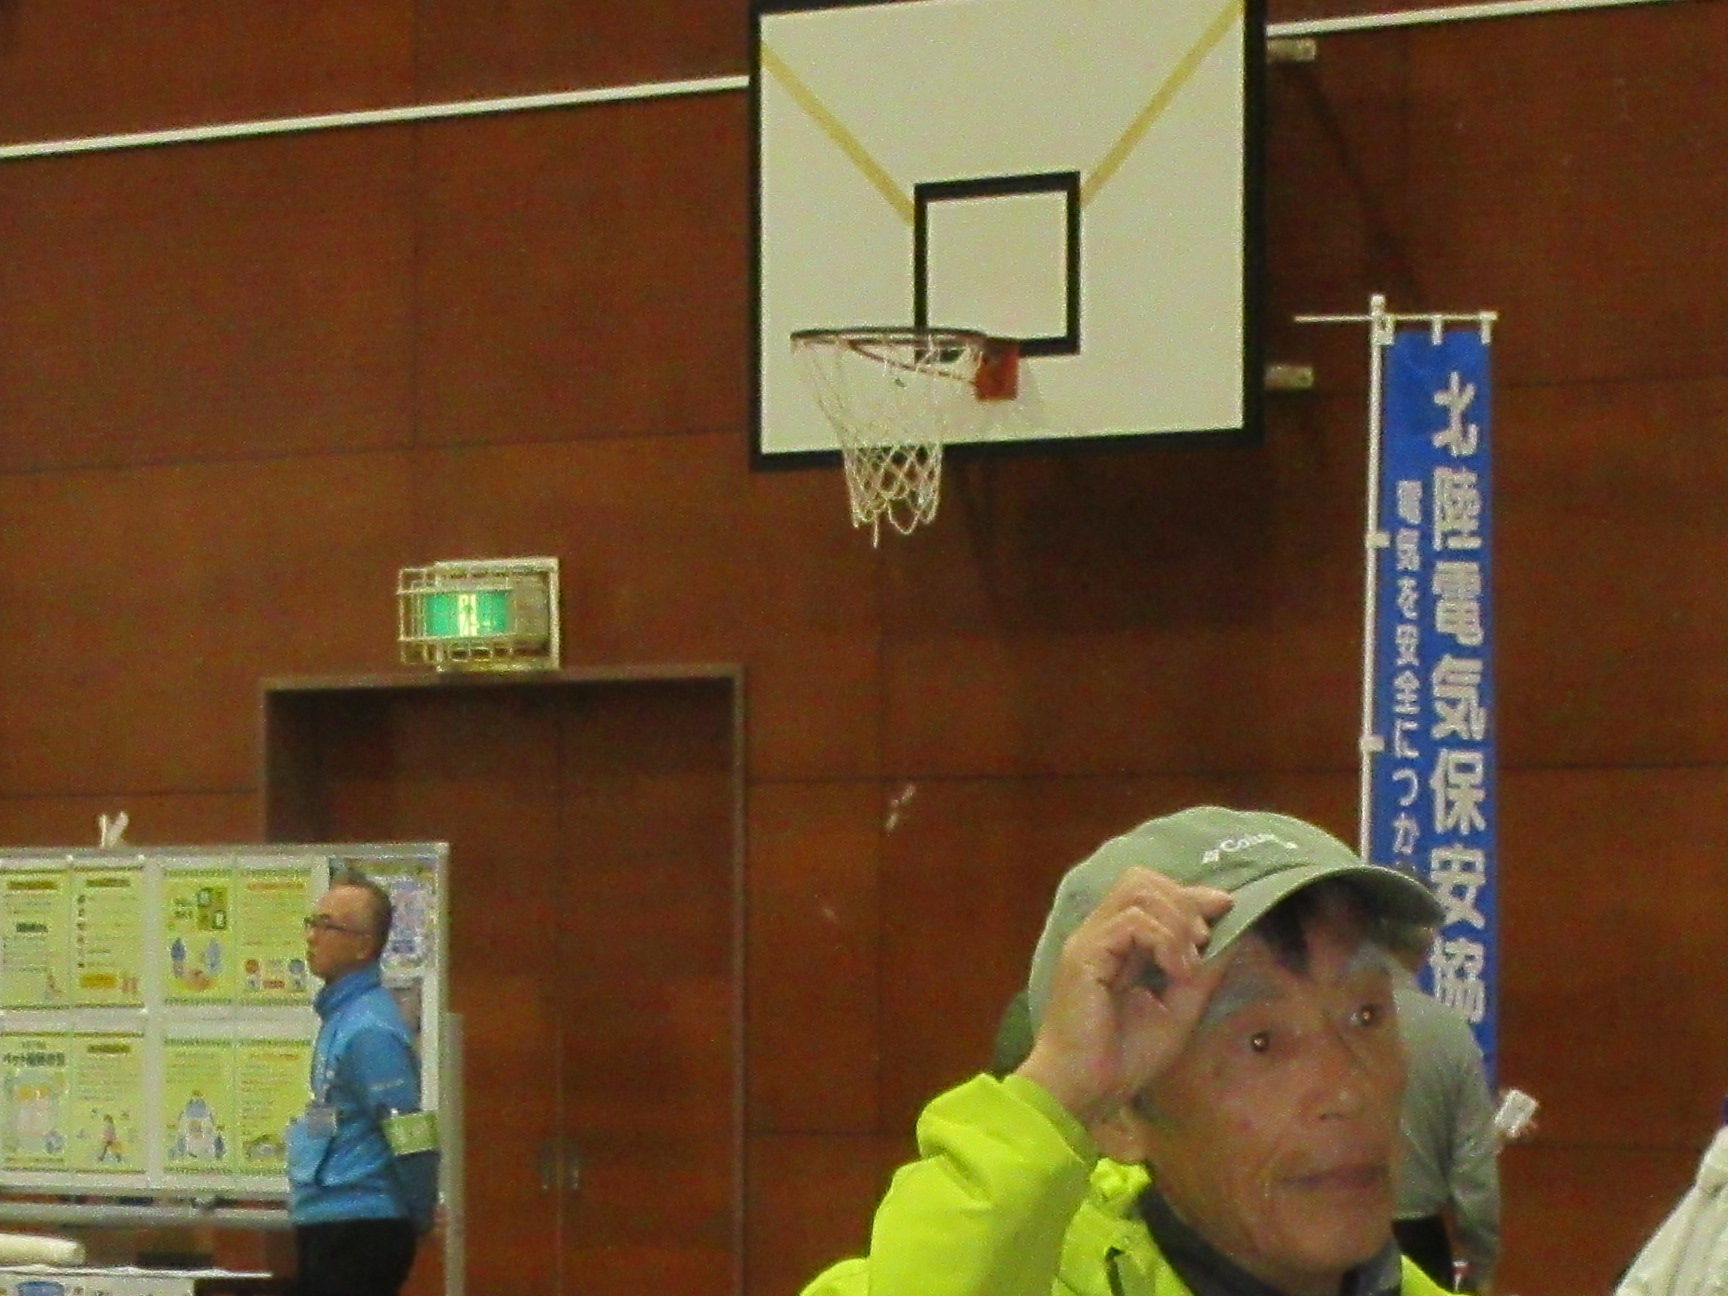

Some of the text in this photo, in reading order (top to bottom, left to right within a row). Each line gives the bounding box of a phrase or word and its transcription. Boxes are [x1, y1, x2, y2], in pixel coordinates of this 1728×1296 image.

[1392, 480, 1422, 870] 電気を安全につか
